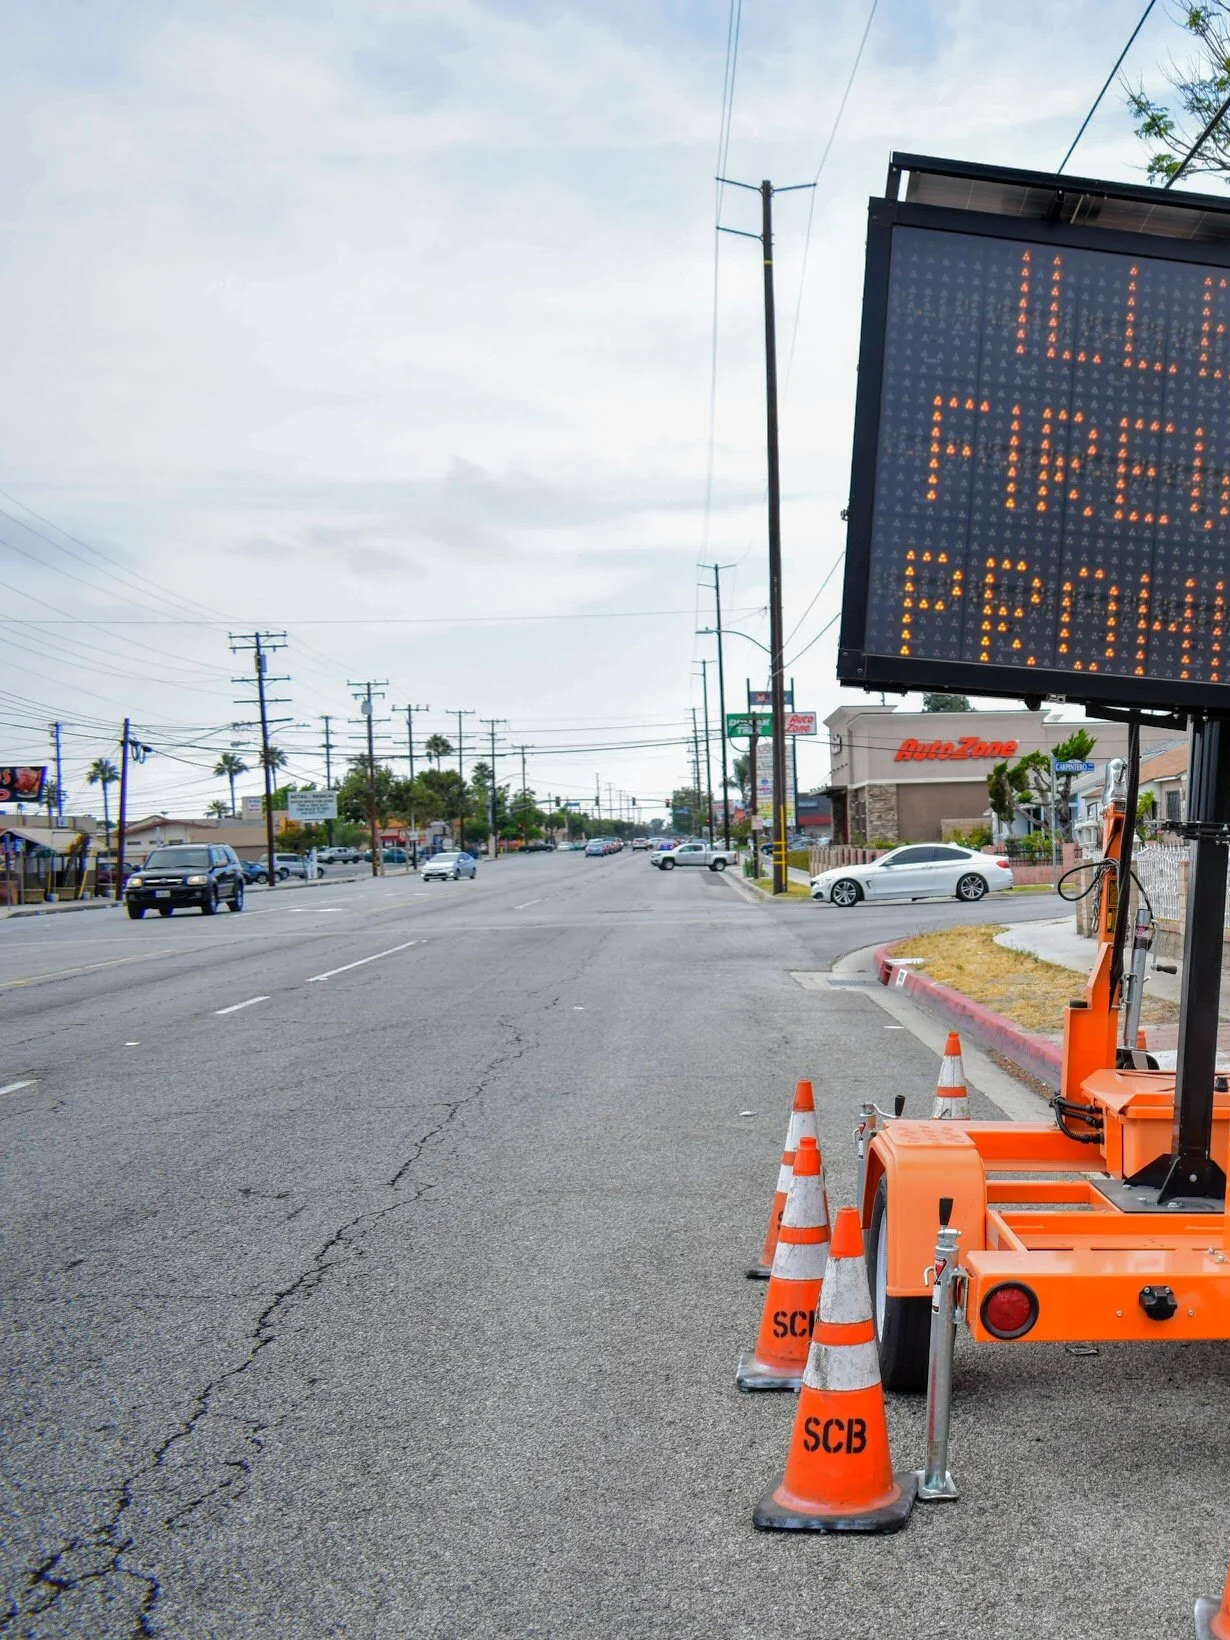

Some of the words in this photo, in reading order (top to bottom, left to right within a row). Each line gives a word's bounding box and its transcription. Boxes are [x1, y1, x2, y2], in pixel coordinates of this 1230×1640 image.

[893, 736, 1018, 762] AutoZone
[1055, 763, 1088, 771] CARPINTERO
[803, 1416, 867, 1454] SCB
